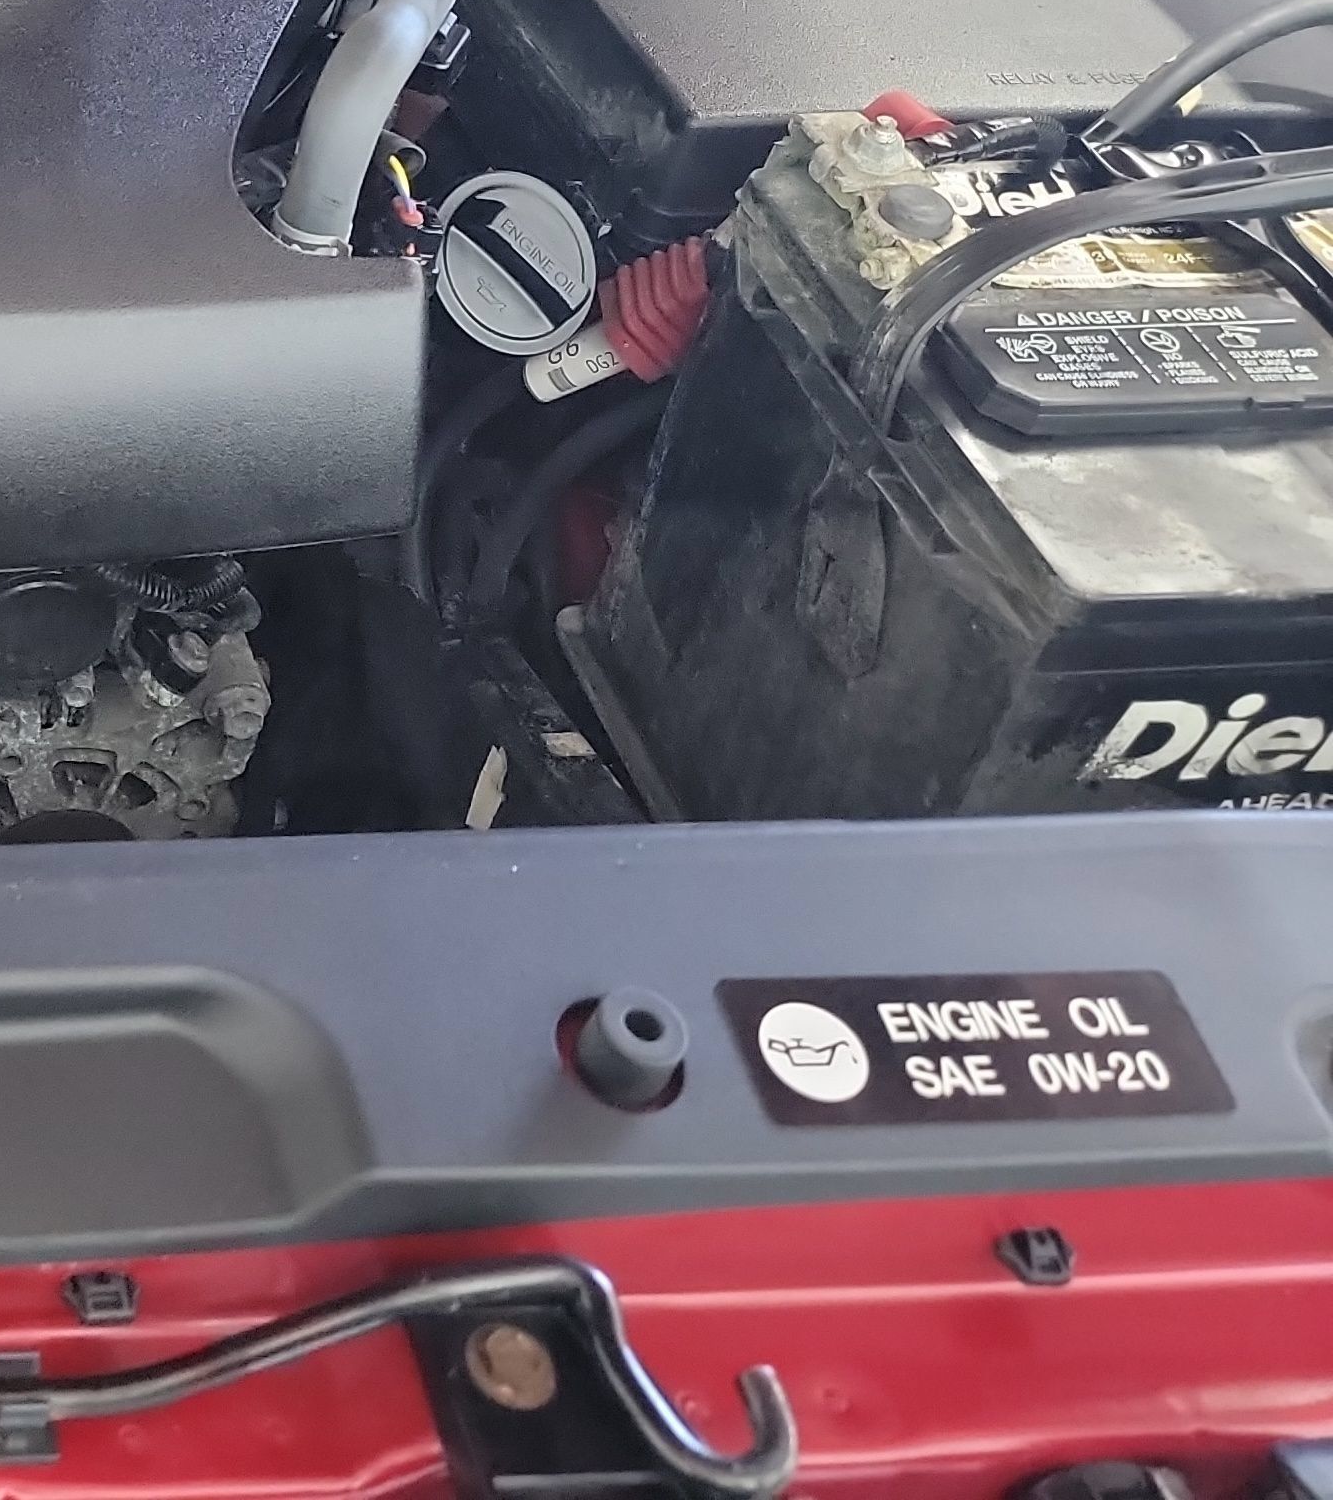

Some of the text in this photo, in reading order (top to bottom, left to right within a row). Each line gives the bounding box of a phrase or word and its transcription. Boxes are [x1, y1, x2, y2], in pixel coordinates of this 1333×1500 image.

[985, 71, 1056, 86] RELAY
[1088, 71, 1146, 85] FUSE
[945, 170, 1076, 217] DieH
[501, 218, 577, 298] ENGINE OIL
[1036, 309, 1136, 327] DANGER
[1154, 306, 1247, 322] POISON
[1064, 334, 1109, 345] SHIELD
[1071, 345, 1105, 354] EYES
[548, 341, 580, 365] G6
[1050, 352, 1119, 363] EXPLOSIVE
[1058, 362, 1102, 372] GASES
[1076, 693, 1333, 781] Die
[877, 997, 1149, 1042] ENGINE OIL
[905, 1050, 1171, 1099] SAE 0W-20
